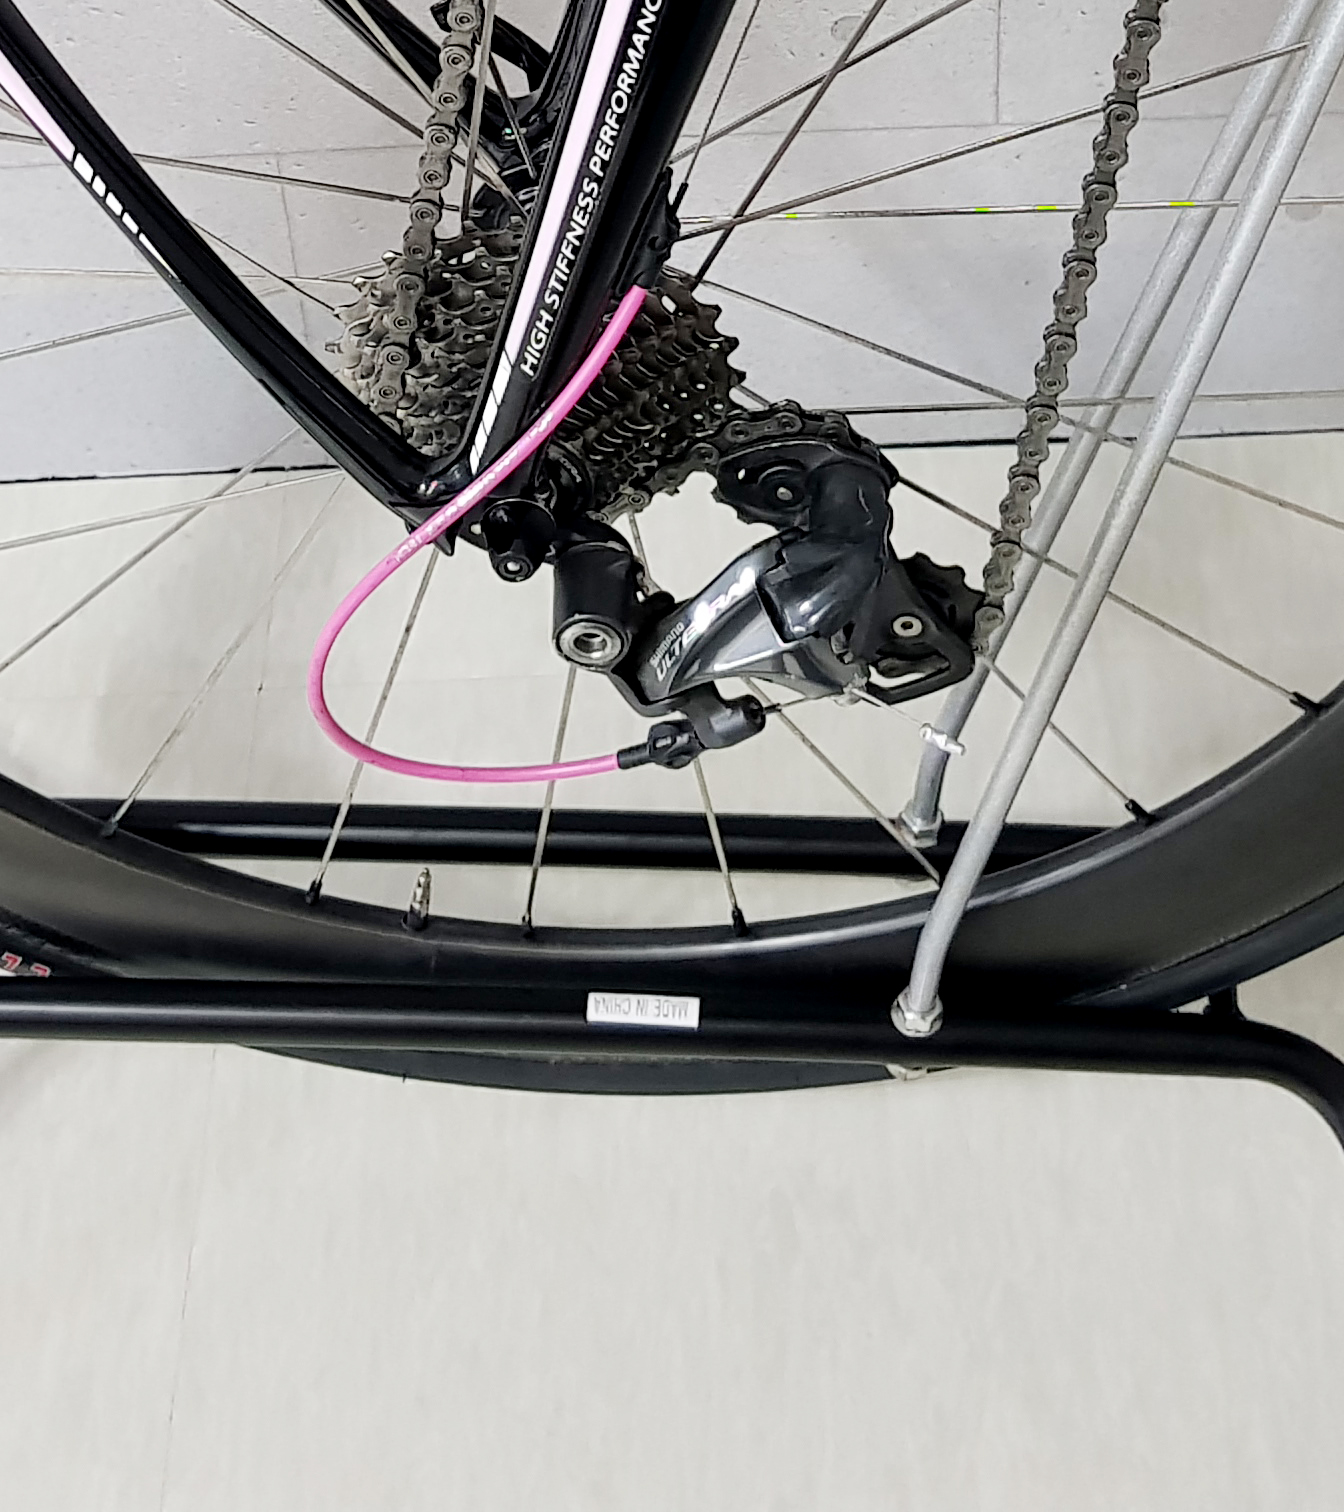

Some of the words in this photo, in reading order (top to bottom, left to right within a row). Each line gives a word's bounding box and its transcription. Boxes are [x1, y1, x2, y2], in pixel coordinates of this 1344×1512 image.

[519, 314, 557, 378] HIGH
[546, 176, 600, 311] STIFFNESS
[649, 621, 684, 668] SHIMANO
[594, 996, 631, 1016] CHINA
[636, 998, 649, 1017] IN
[654, 999, 689, 1020] MADE
